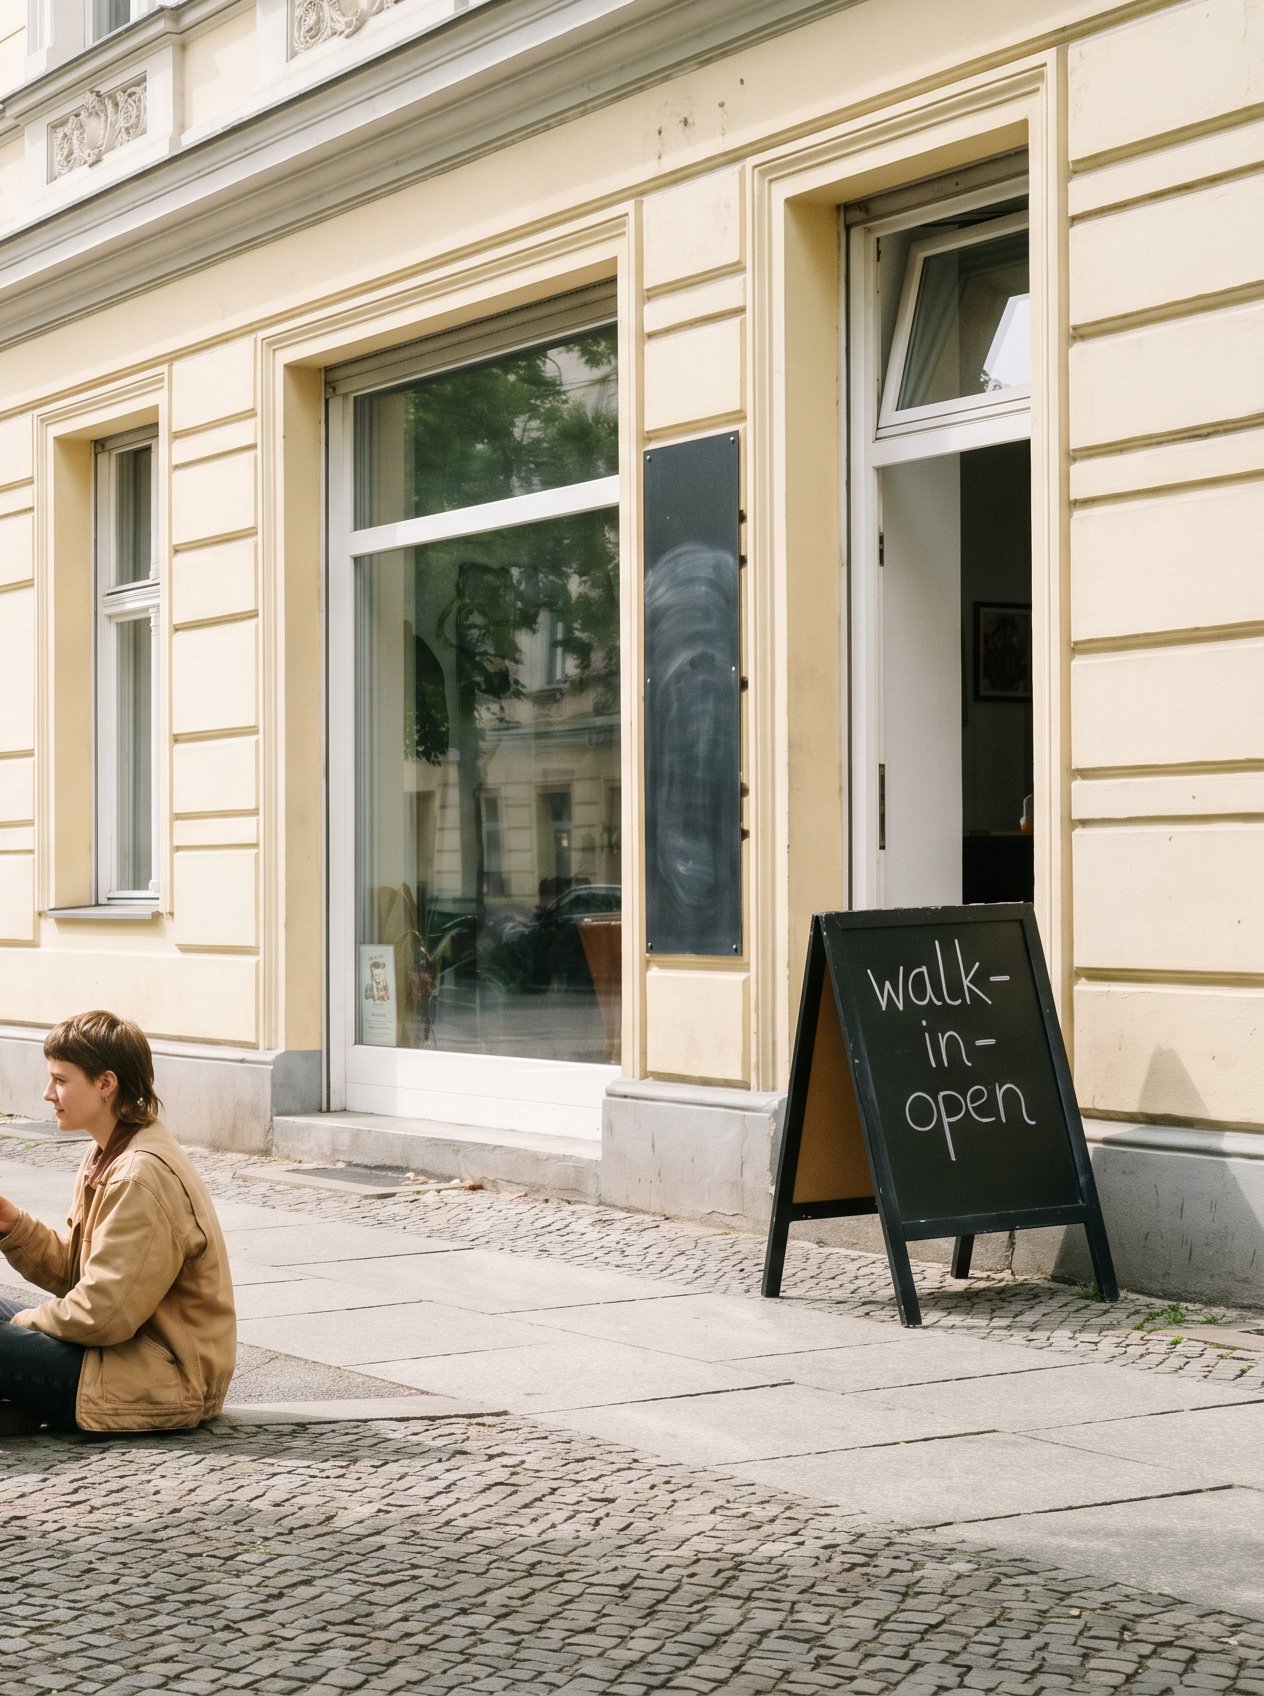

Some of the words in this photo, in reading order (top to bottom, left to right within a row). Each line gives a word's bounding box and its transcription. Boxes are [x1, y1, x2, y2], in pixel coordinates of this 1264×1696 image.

[866, 938, 1010, 1012] walk-
[920, 1019, 997, 1069] in-
[904, 1081, 1037, 1162] open
